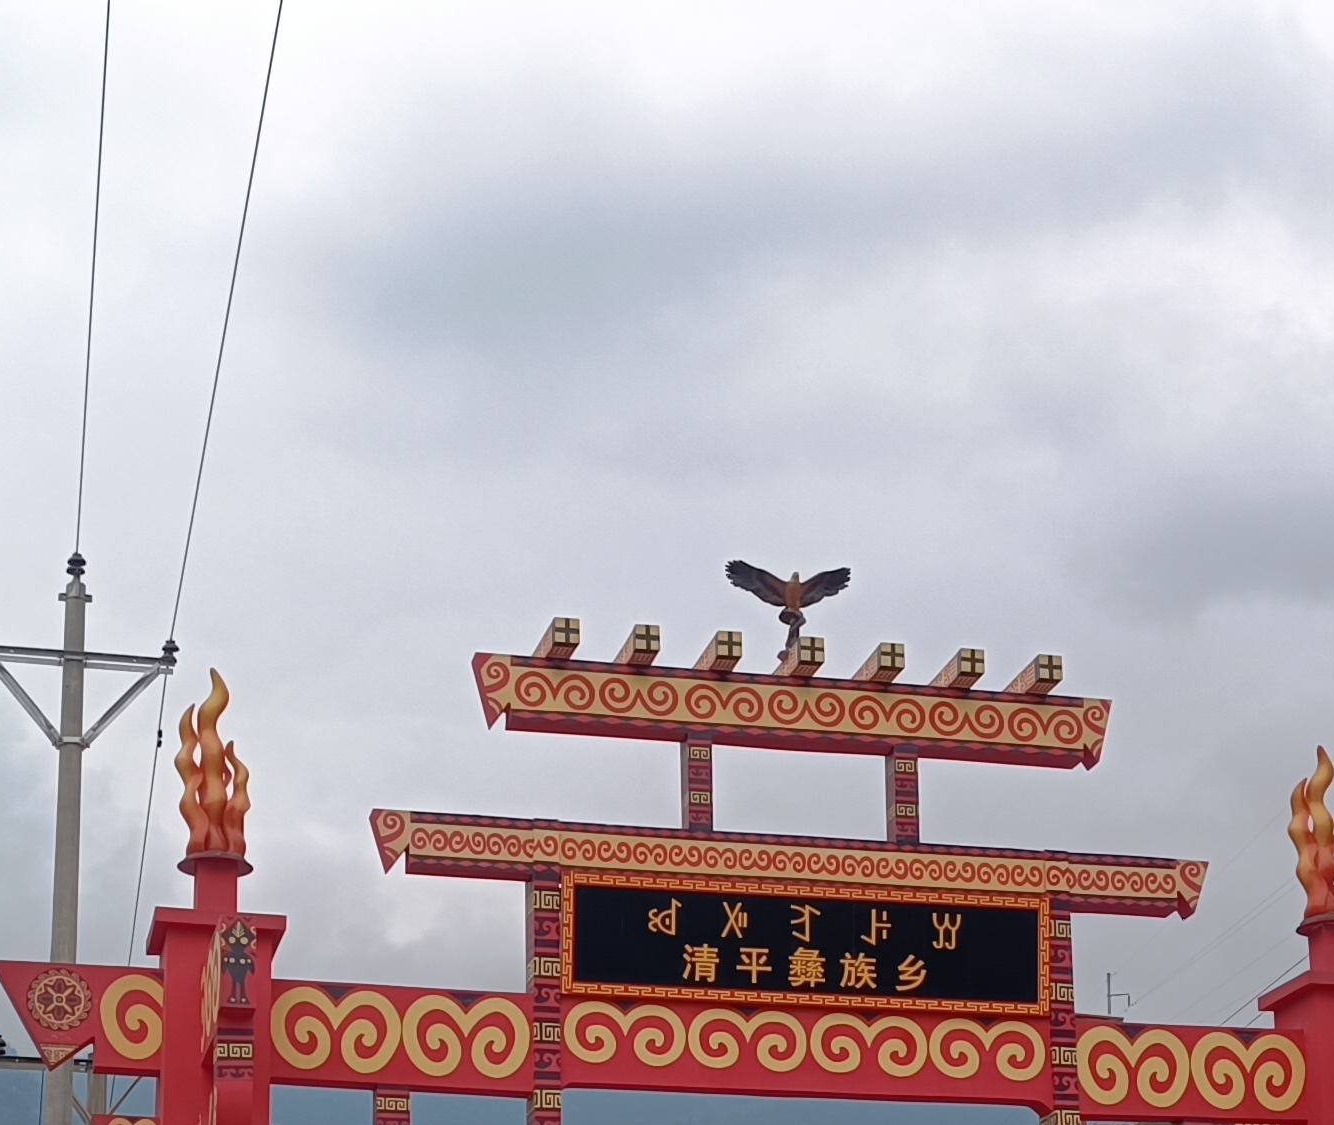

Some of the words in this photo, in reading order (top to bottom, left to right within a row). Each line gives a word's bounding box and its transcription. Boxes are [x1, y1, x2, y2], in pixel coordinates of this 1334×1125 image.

[682, 943, 928, 992] 清平彝族乡
